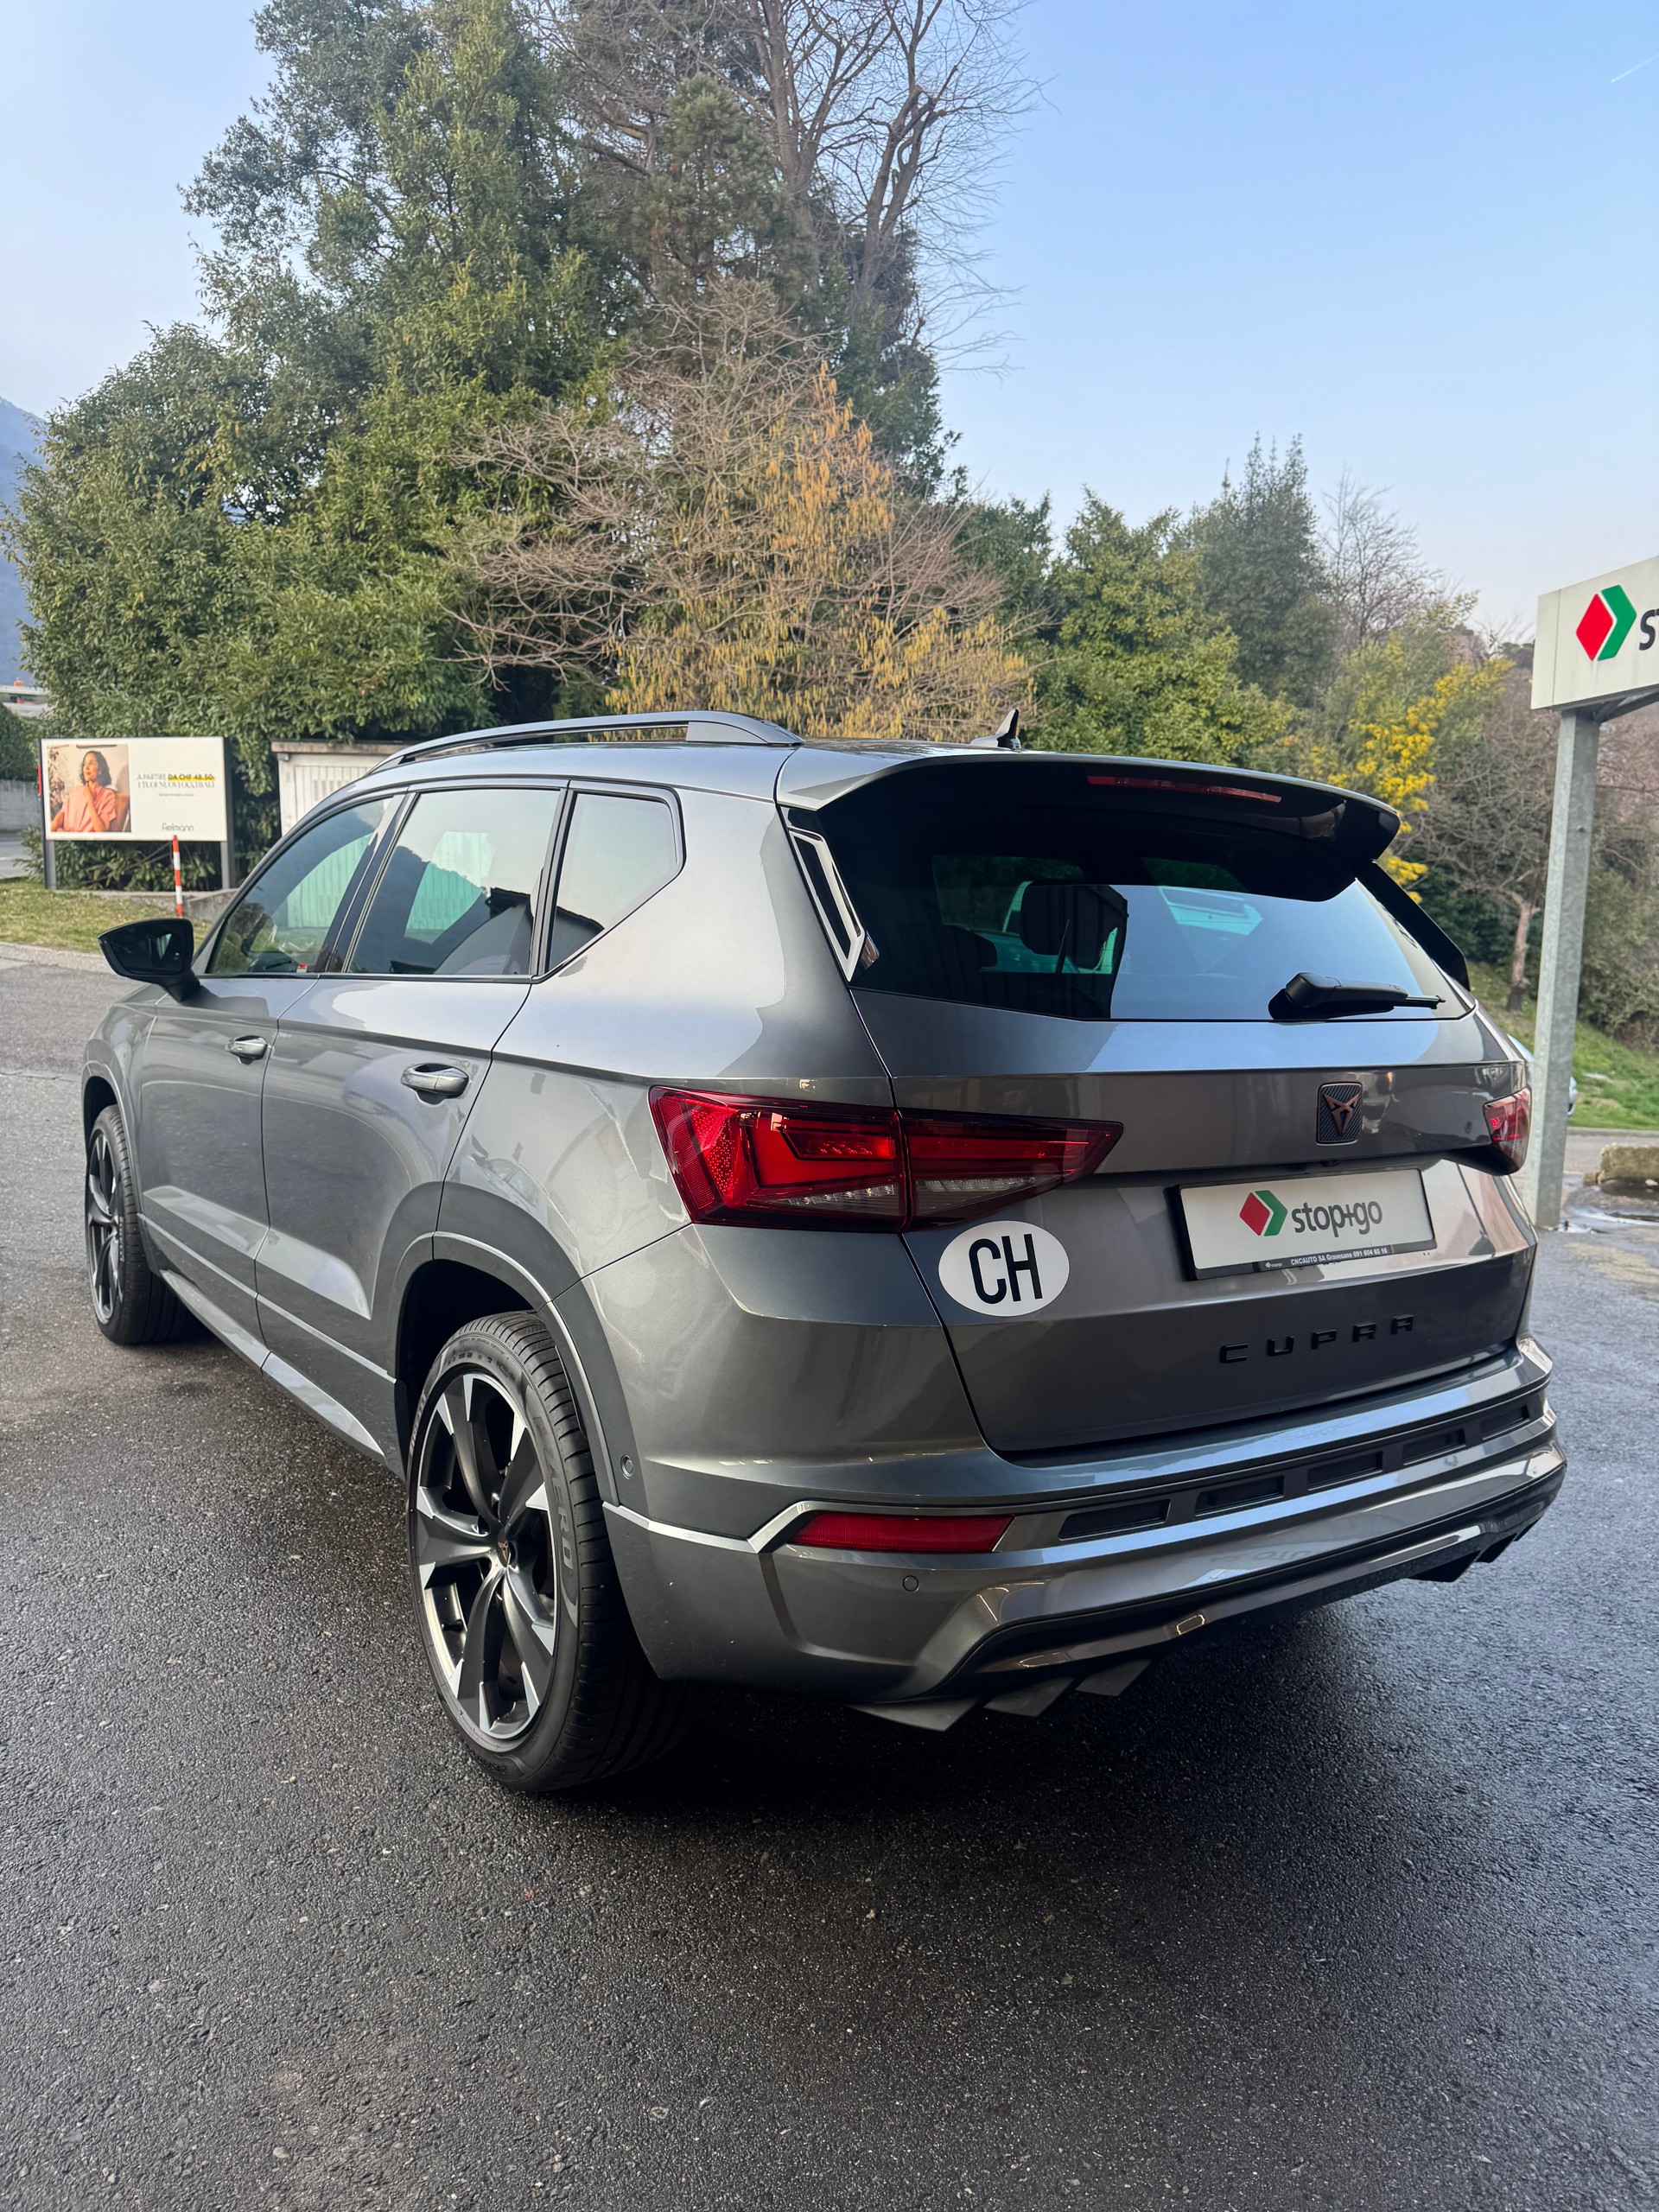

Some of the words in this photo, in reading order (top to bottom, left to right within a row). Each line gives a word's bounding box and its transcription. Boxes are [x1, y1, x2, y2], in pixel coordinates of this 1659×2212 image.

[1291, 1200, 1382, 1237] stop+go
[969, 1233, 1043, 1305] CH
[1290, 1255, 1318, 1266] CNCAUTO
[1326, 1252, 1353, 1261] Gravesano
[1219, 1313, 1414, 1363] CUPRA
